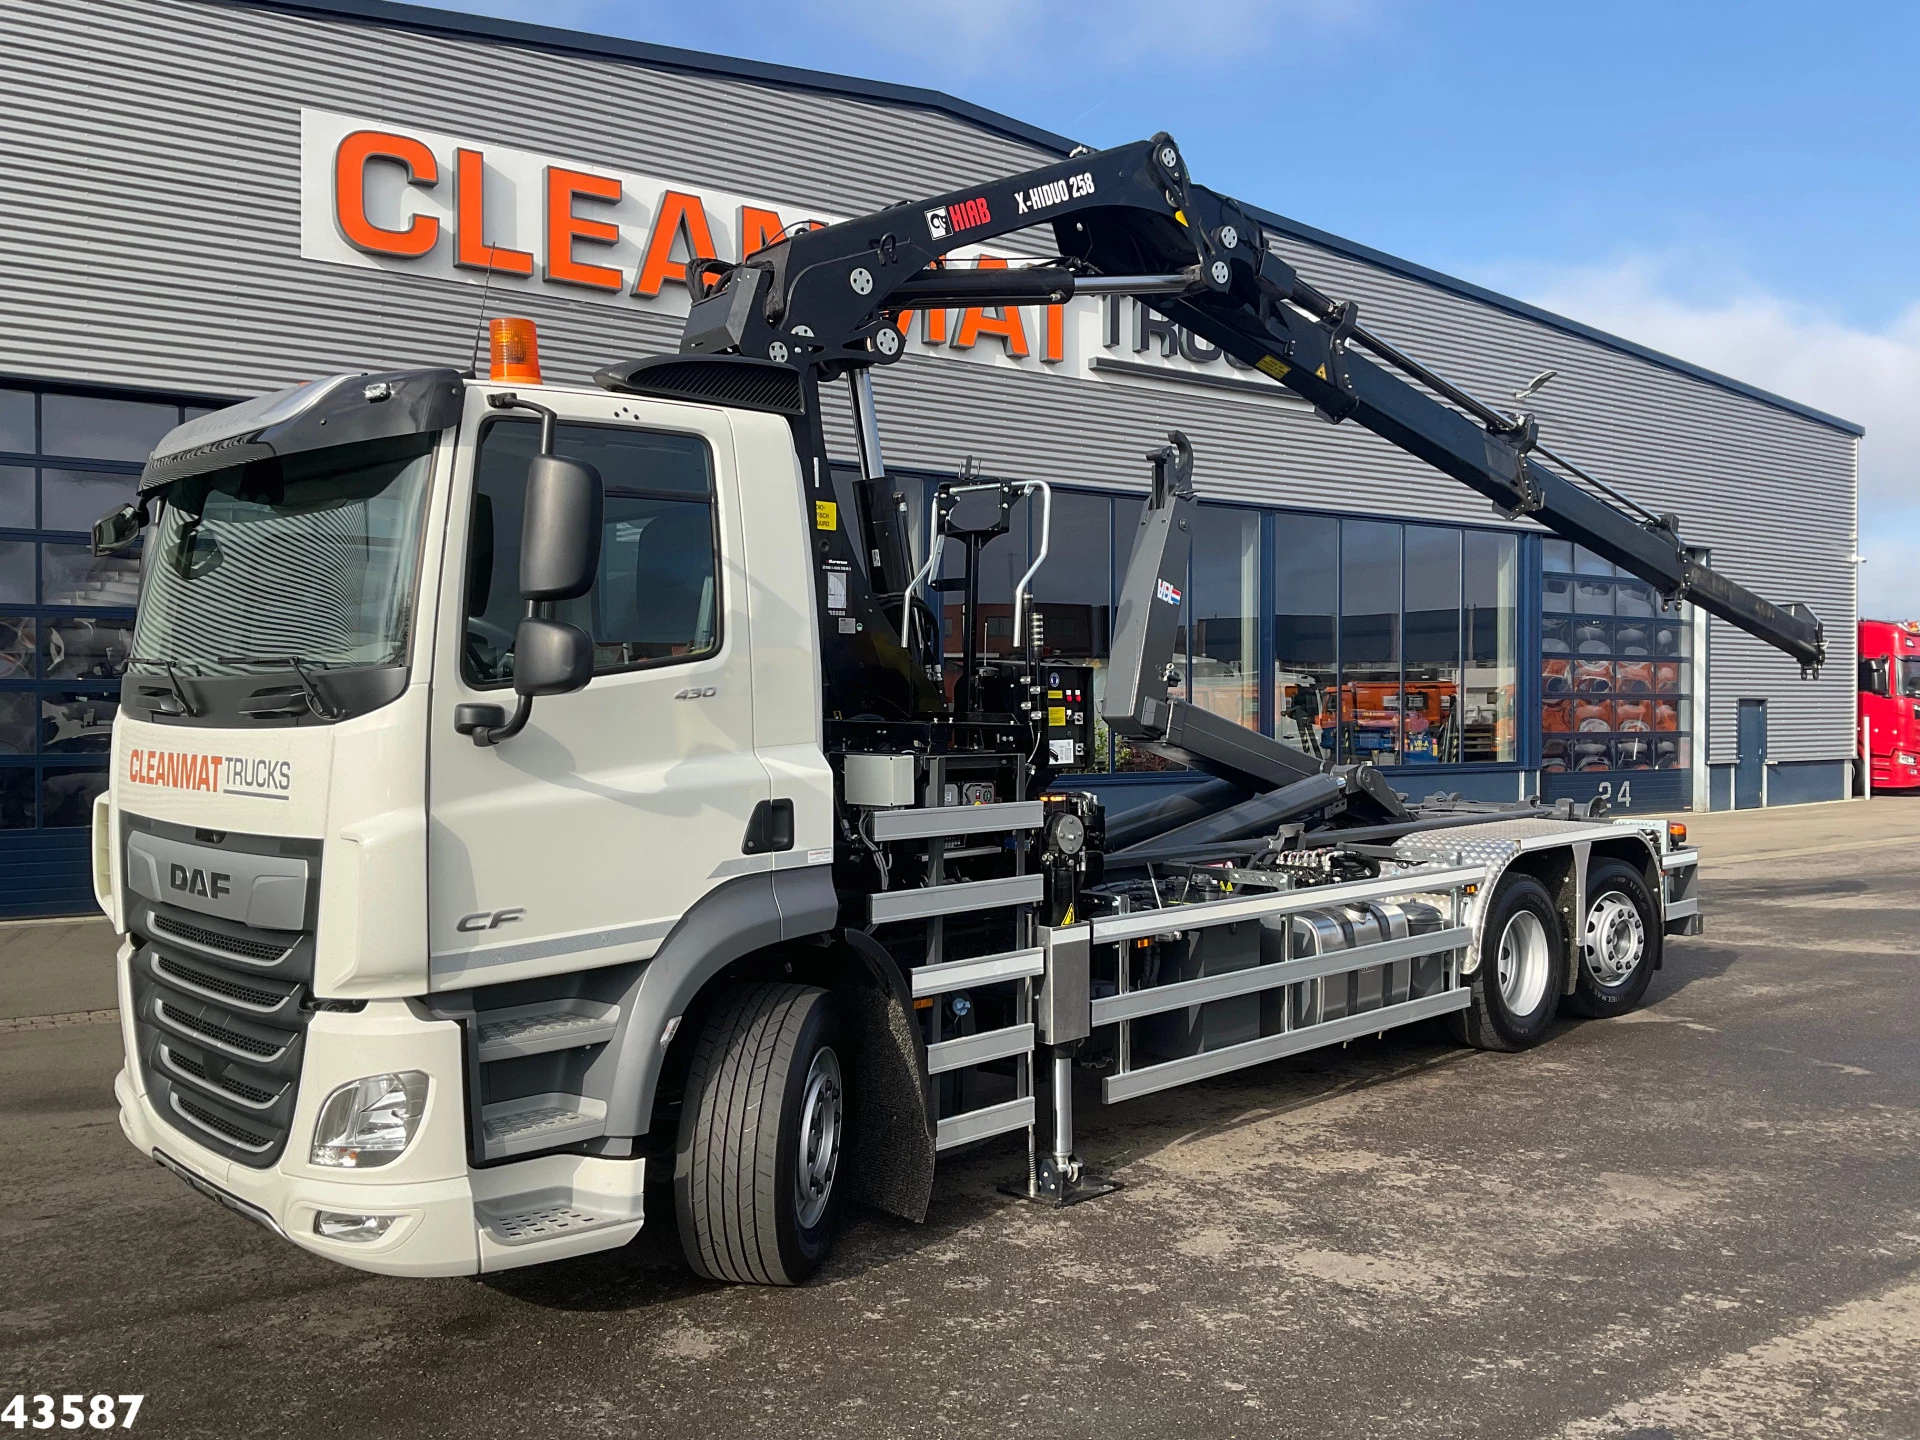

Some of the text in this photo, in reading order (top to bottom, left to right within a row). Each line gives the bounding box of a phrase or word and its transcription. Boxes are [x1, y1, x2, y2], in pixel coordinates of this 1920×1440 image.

[1014, 172, 1096, 215] X-HIDUO 258
[948, 197, 991, 232] HIAB
[674, 686, 717, 700] 430
[129, 748, 291, 793] CLEANMAT TRUCKS
[1598, 780, 1632, 808] 24
[170, 863, 231, 900] DAF
[456, 907, 525, 933] CF
